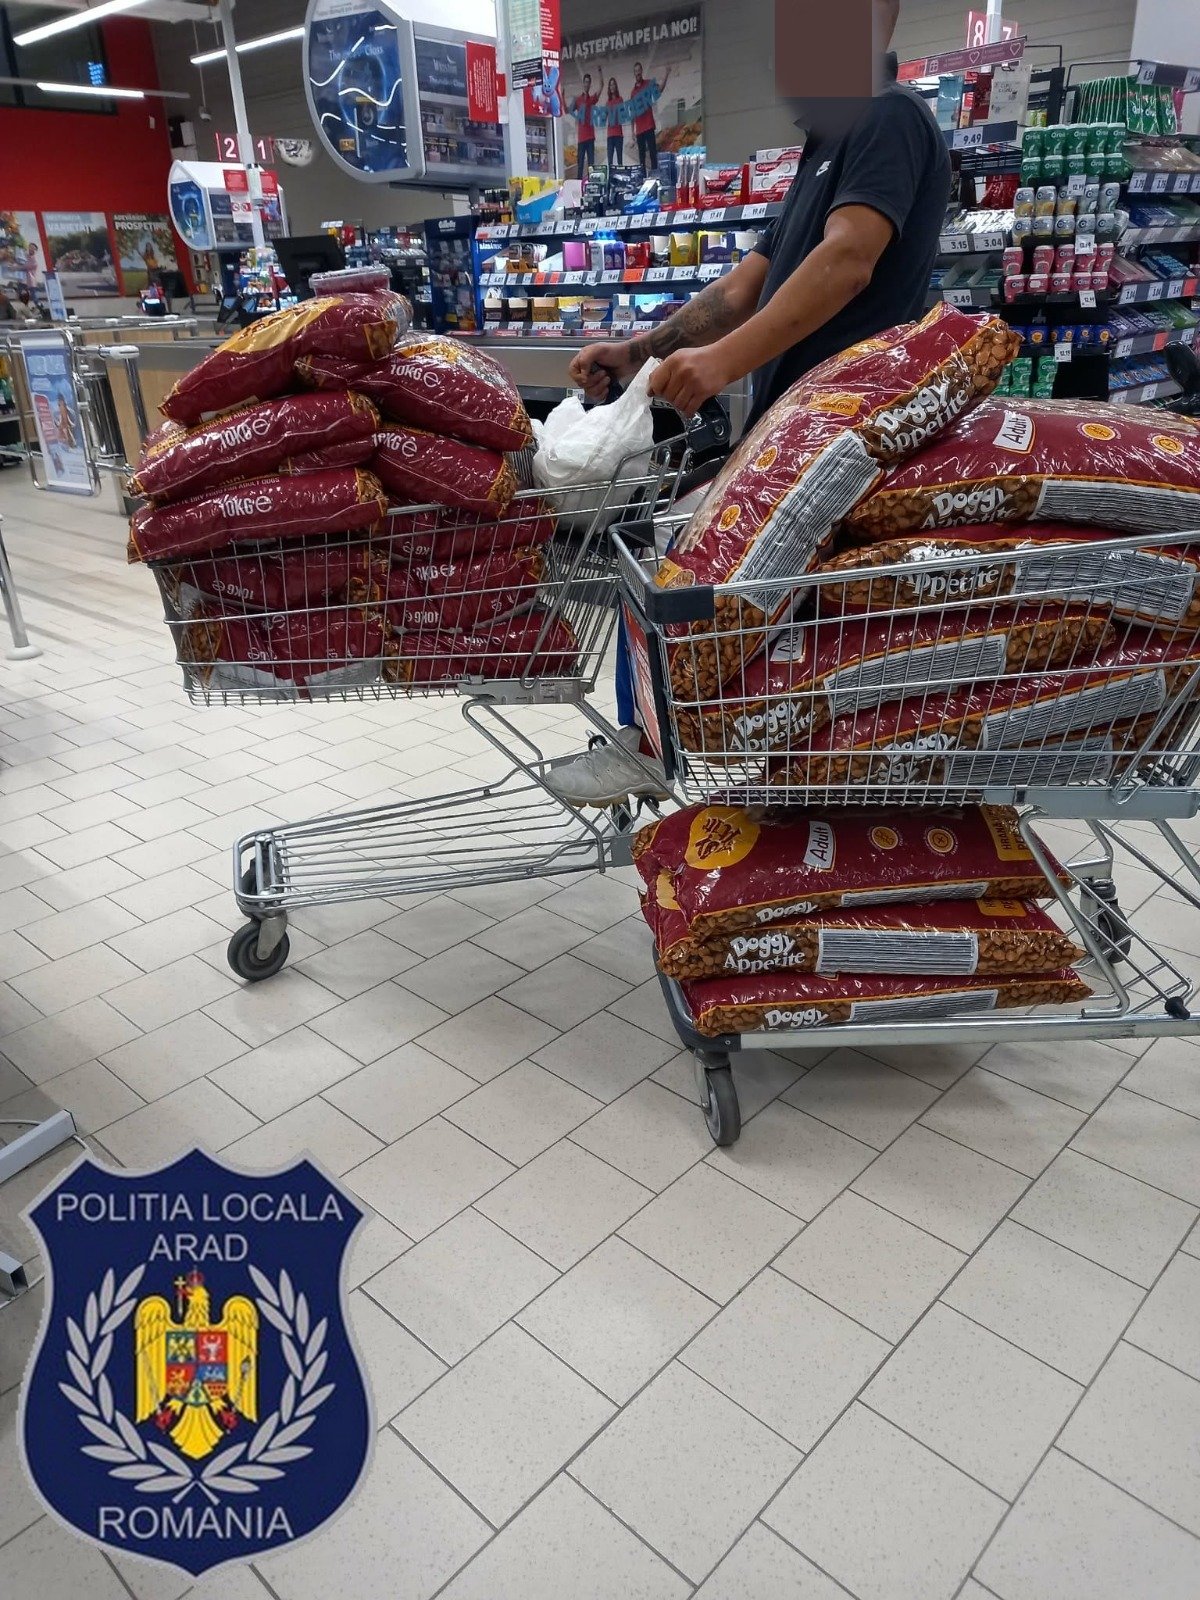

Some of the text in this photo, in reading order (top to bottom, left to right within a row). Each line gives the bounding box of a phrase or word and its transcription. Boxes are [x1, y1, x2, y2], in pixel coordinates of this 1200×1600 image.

[636, 27, 650, 44] PE
[653, 24, 668, 41] LA
[671, 17, 698, 37] NOI!
[973, 20, 984, 47] 8
[1002, 26, 1012, 41] 7
[223, 137, 237, 158] 2
[257, 139, 266, 160] 1
[963, 134, 981, 144] 9.49
[950, 241, 967, 249] 3.15
[984, 237, 1002, 247] 3.04
[953, 295, 970, 303] 3.49
[390, 364, 422, 380] 10KG
[875, 379, 949, 434] Doggy
[880, 389, 969, 453] Appetite
[1001, 416, 1027, 444] Adult
[219, 423, 252, 451] 10KG
[220, 494, 253, 518] 10KG
[932, 486, 1013, 516] Doggy
[226, 584, 254, 600] 10KG
[729, 709, 818, 753] Appetite
[734, 701, 802, 738] Doggy
[882, 732, 957, 763] Doggy
[810, 826, 829, 862] Adult
[756, 901, 818, 923] Doggy
[730, 932, 796, 958] Doggy
[723, 952, 805, 973] Appetite
[764, 1007, 829, 1027] Doggy
